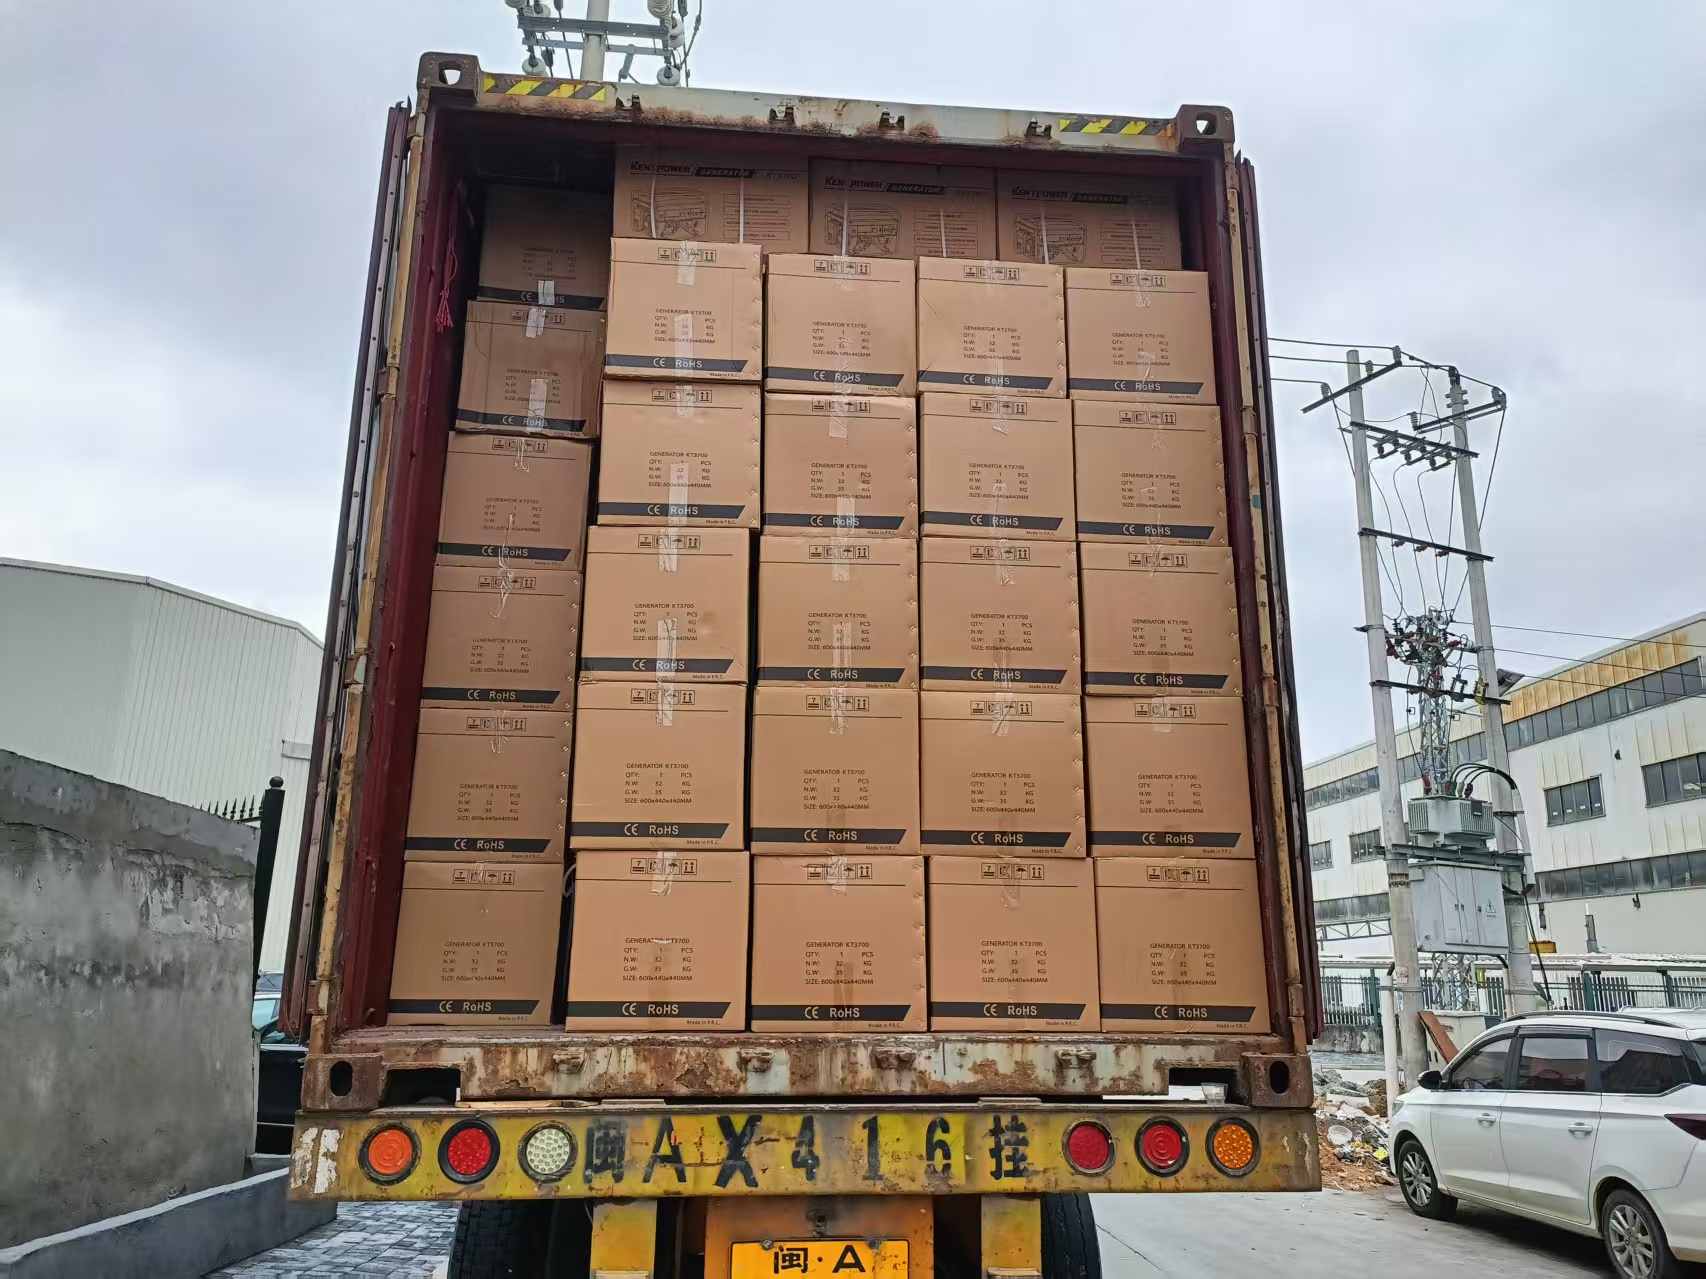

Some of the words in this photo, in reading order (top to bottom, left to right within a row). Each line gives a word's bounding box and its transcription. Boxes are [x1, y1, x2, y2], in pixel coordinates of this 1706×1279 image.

[653, 358, 665, 367] CE
[675, 359, 702, 368] RoHS
[814, 371, 824, 380] CE
[835, 372, 860, 382] RoHS
[963, 375, 975, 383] CE
[984, 376, 1009, 385] RoHS
[1114, 381, 1125, 390] CE
[1135, 383, 1160, 391] RoHS
[503, 416, 513, 424] CE
[648, 505, 660, 514] CE
[670, 505, 698, 514] RoHS
[810, 516, 823, 526] CE
[832, 517, 859, 526] RoHS
[970, 515, 982, 524] CE
[992, 516, 1018, 526] RoHS
[1123, 525, 1135, 534] CE
[1144, 526, 1170, 535] RoHS
[482, 546, 494, 555] CE
[504, 546, 528, 556] RoHS
[633, 660, 645, 669] CE
[656, 661, 684, 670] RoHS
[808, 669, 820, 679] CE
[830, 670, 857, 679] RoHS
[971, 669, 983, 679] CE
[993, 670, 1021, 680] RoHS
[1134, 674, 1147, 684] CE
[1156, 676, 1183, 684] RoHS
[468, 690, 480, 699] CE
[490, 691, 516, 700] RoHS
[624, 824, 639, 835] CE
[649, 825, 679, 834] RoHS
[804, 830, 817, 840] CE
[828, 831, 857, 840] RoHS
[971, 832, 984, 843] CE
[994, 833, 1023, 842] RoHS
[1142, 833, 1155, 844] CE
[1166, 834, 1194, 843] RoHS
[455, 840, 467, 849] CE
[477, 840, 504, 849] RoHS
[440, 1001, 452, 1011] CE
[463, 1002, 491, 1011] RoHS
[622, 1003, 637, 1015] CE
[648, 1004, 679, 1014] RoHS
[984, 1004, 998, 1015] CE
[1008, 1005, 1037, 1015] RoHS
[805, 1007, 819, 1018] CE
[830, 1008, 860, 1017] RoHS
[1154, 1006, 1168, 1017] CE
[1178, 1008, 1207, 1017] RoHS
